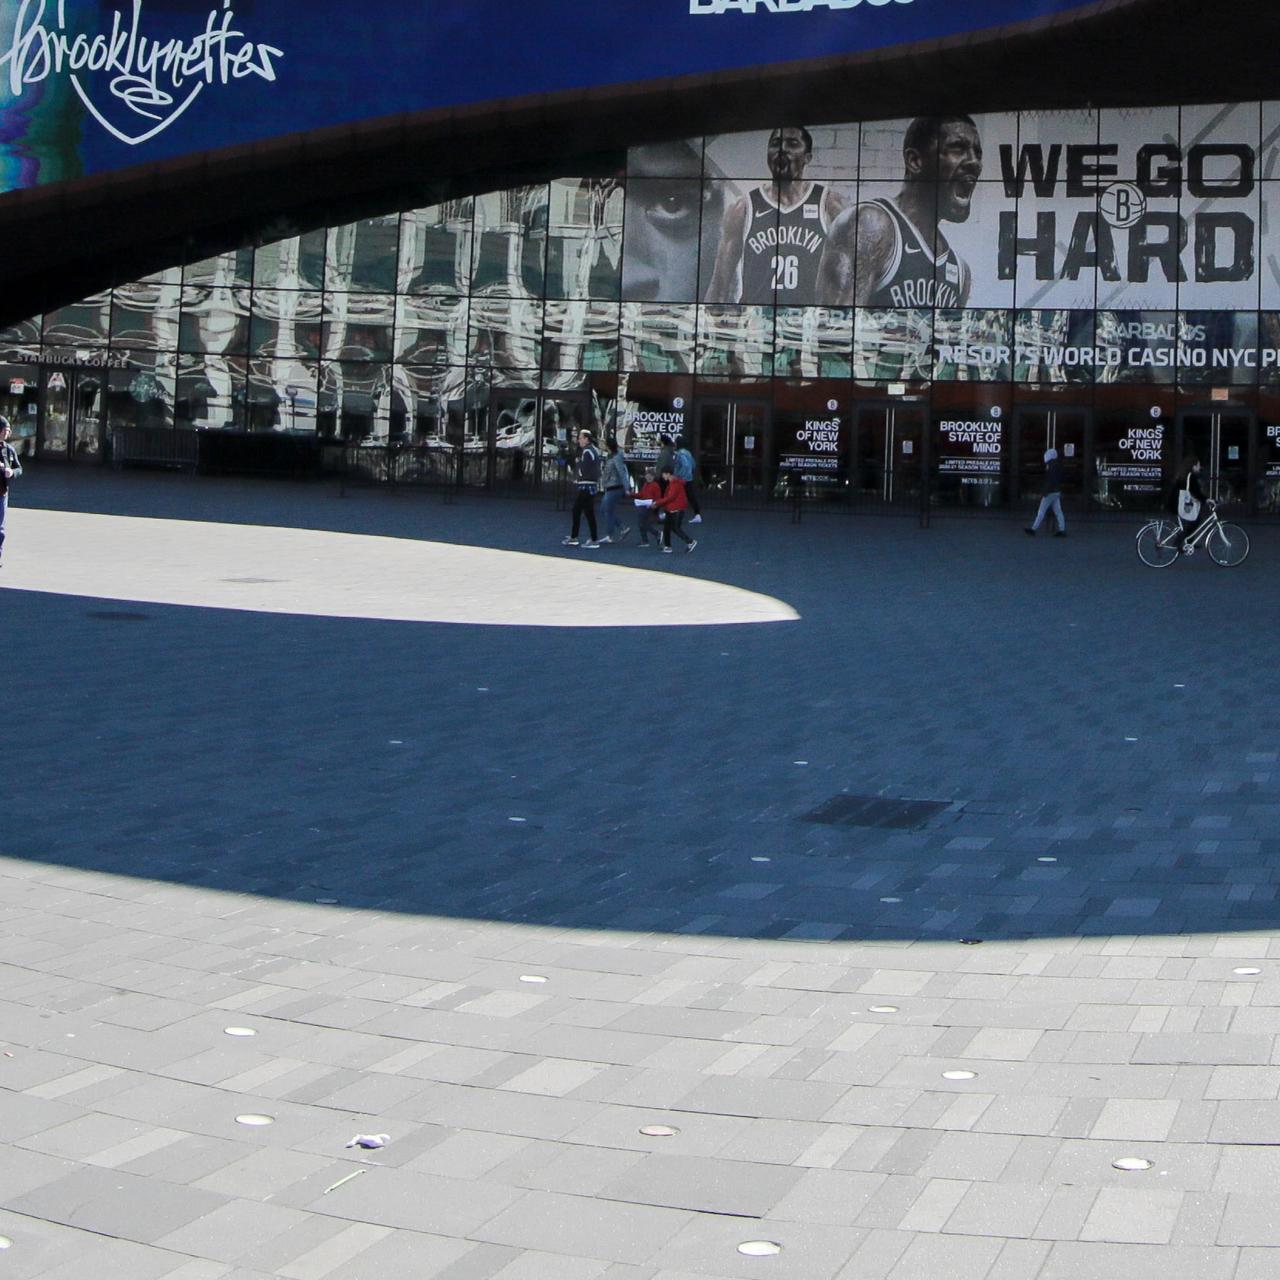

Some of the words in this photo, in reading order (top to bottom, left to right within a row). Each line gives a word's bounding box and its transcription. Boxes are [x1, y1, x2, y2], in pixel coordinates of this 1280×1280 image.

[998, 143, 1119, 198] WE
[1136, 143, 1256, 199] GO
[748, 225, 823, 255] BROOKLYN
[997, 210, 1256, 283] HARD
[770, 254, 799, 290] 26
[940, 346, 1040, 365] RESORTS
[1042, 347, 1121, 366] WORLD
[1128, 347, 1207, 368] CASINO
[1212, 348, 1257, 368] NYC
[805, 420, 839, 431] KINGS
[940, 421, 1001, 432] BROOKLYN
[796, 430, 812, 440] OF
[813, 431, 839, 441] NEW
[948, 432, 983, 442] STATE
[985, 432, 1001, 442] OF
[1128, 428, 1163, 439] KINGS
[808, 441, 838, 451] YORK
[973, 442, 1001, 453] MIND
[1119, 438, 1135, 449] OF
[1136, 439, 1162, 449] NEW
[1131, 449, 1162, 460] YORK
